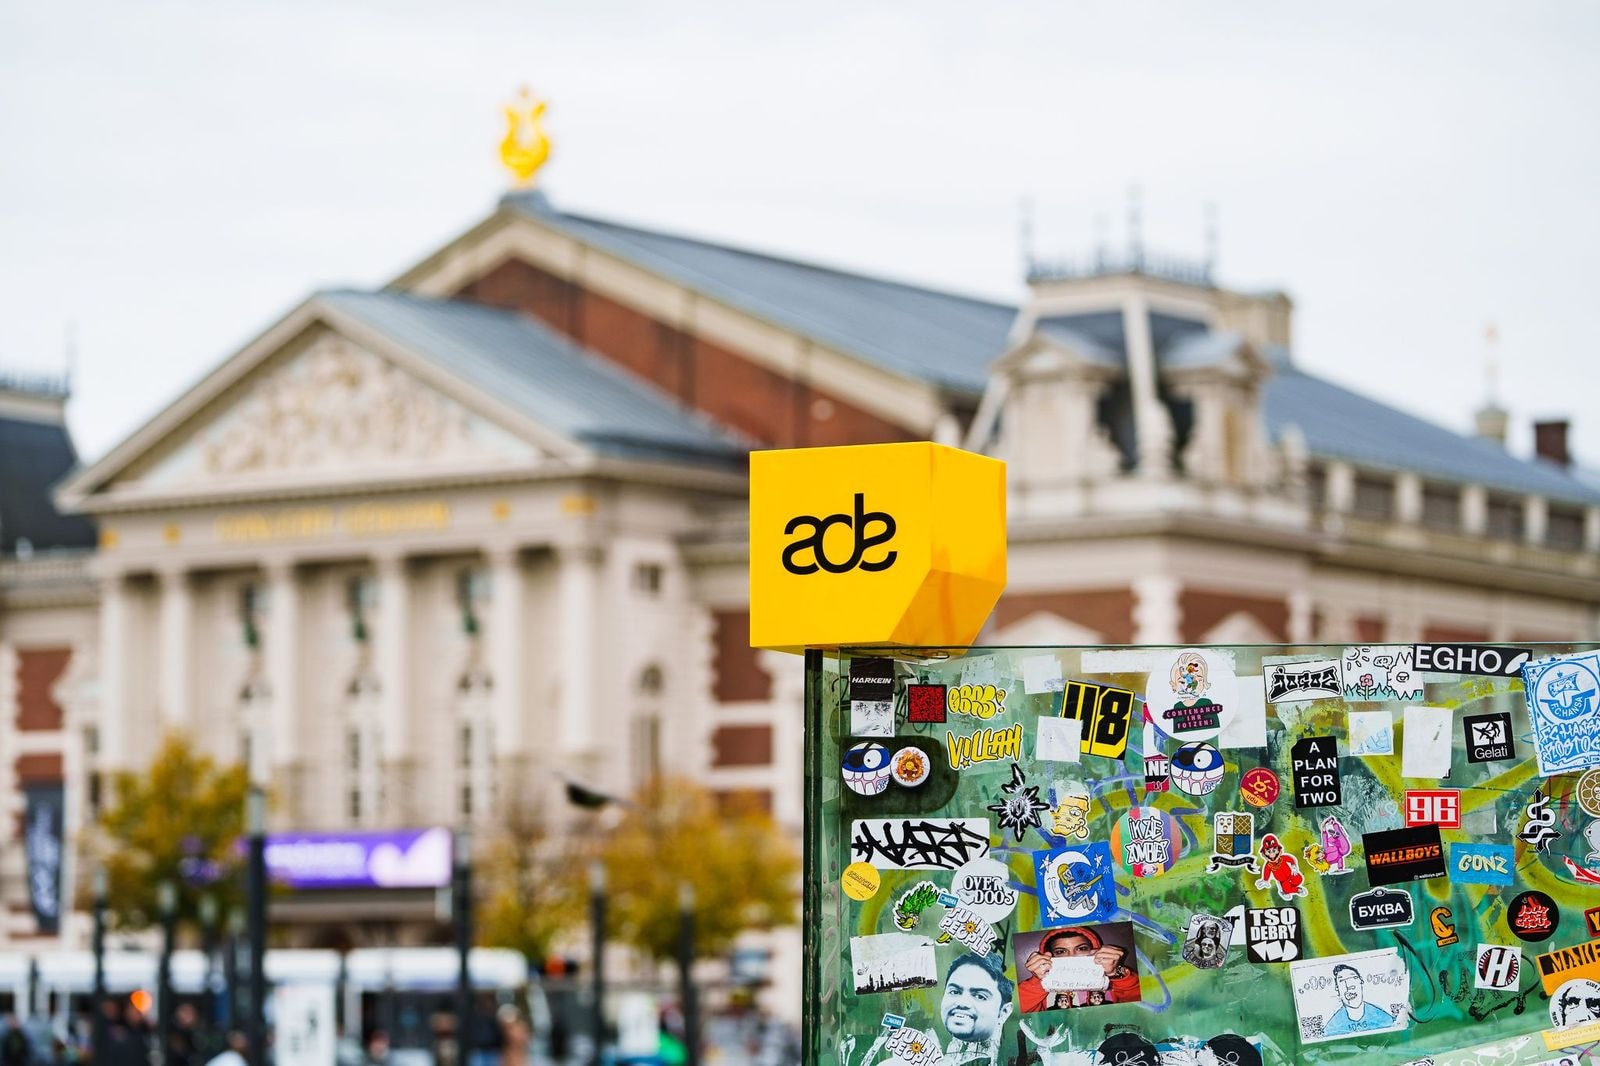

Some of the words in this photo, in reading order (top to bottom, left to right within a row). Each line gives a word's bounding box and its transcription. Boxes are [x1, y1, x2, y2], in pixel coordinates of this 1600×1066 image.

[781, 493, 898, 575] ade
[1416, 646, 1502, 674] EGHO
[1166, 705, 1220, 718] CONTENANCE
[1310, 742, 1320, 753] A
[1474, 747, 1508, 760] Gelati
[1295, 757, 1337, 770] PLAN
[1301, 775, 1334, 788] FOR
[1300, 791, 1337, 805] TWO
[1408, 796, 1457, 822] 96
[1369, 845, 1440, 866] WALLBOYS
[1458, 854, 1508, 874] GONZ
[1249, 907, 1297, 926] TSO
[1358, 902, 1405, 918] БУКВА
[1250, 924, 1297, 941] DEBRY
